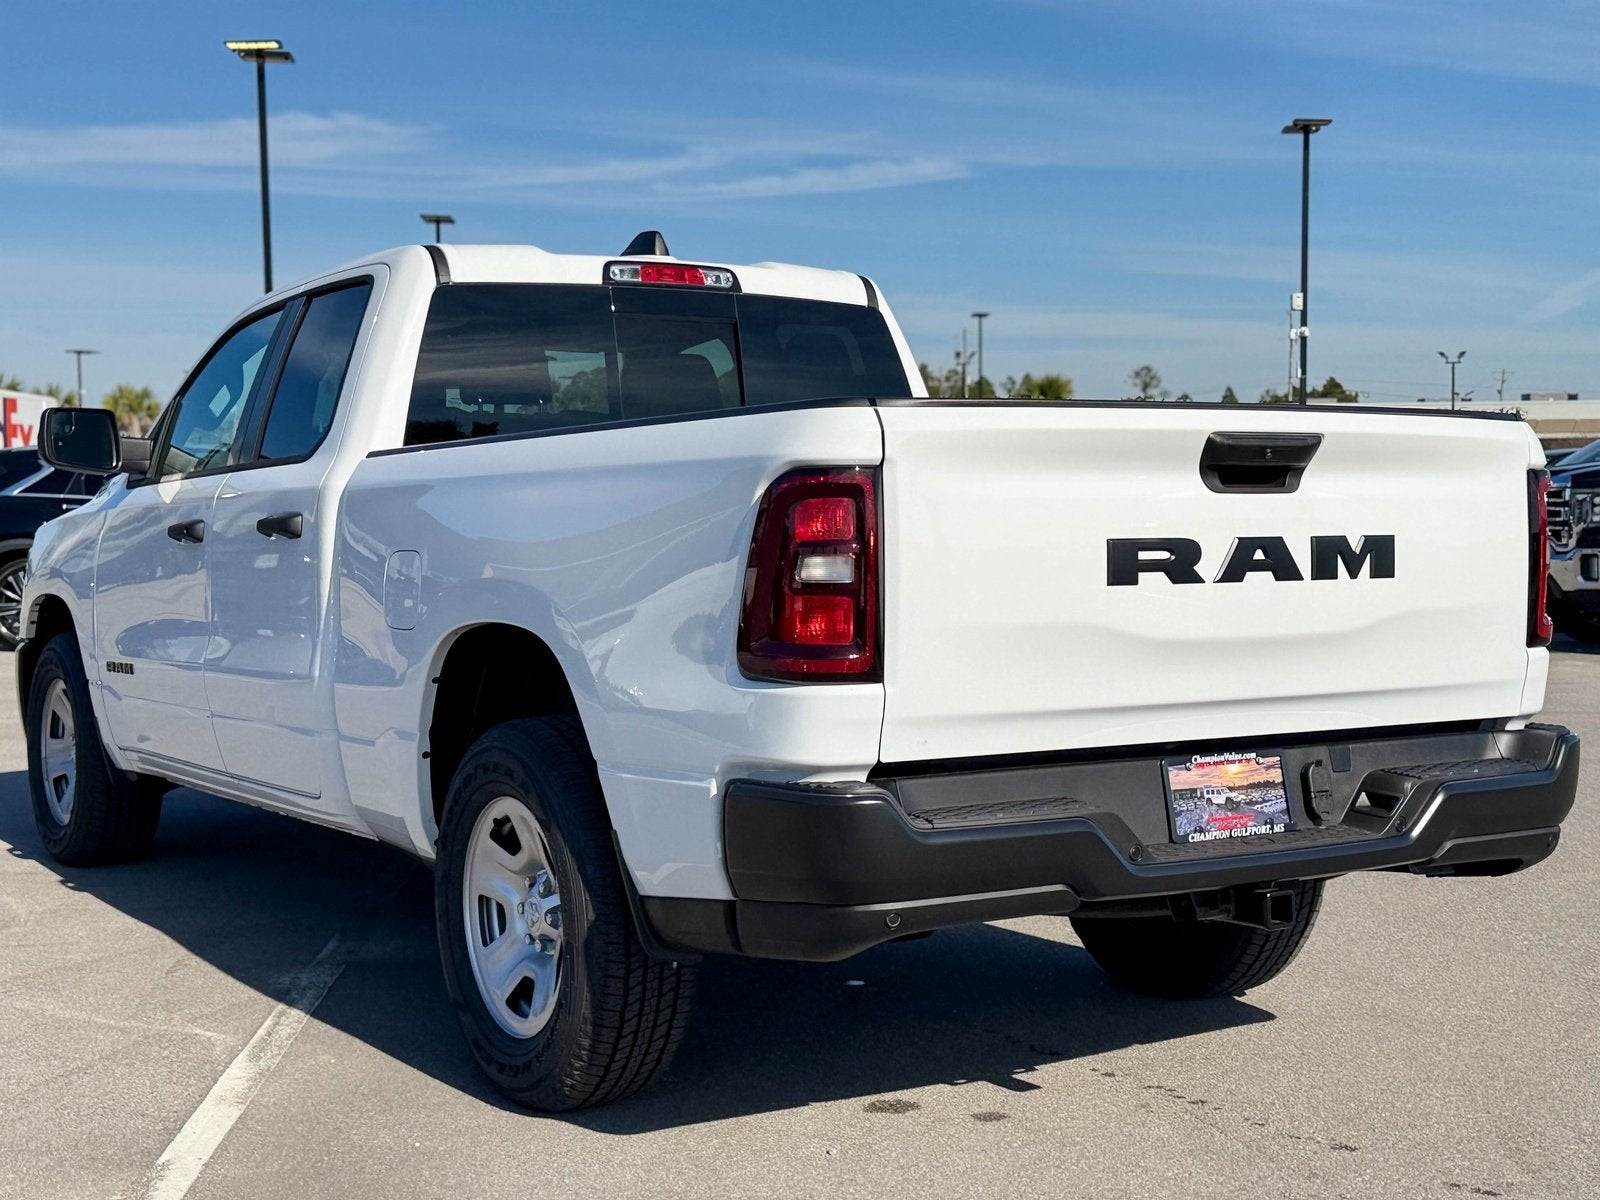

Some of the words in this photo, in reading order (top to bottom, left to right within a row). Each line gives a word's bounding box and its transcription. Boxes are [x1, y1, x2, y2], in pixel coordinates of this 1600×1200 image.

[1107, 535, 1395, 586] RAM
[106, 660, 135, 676] RAM
[1188, 829, 1231, 842] CHAMPION
[1231, 825, 1273, 838] GULFPORT,
[1273, 823, 1285, 833] MS
